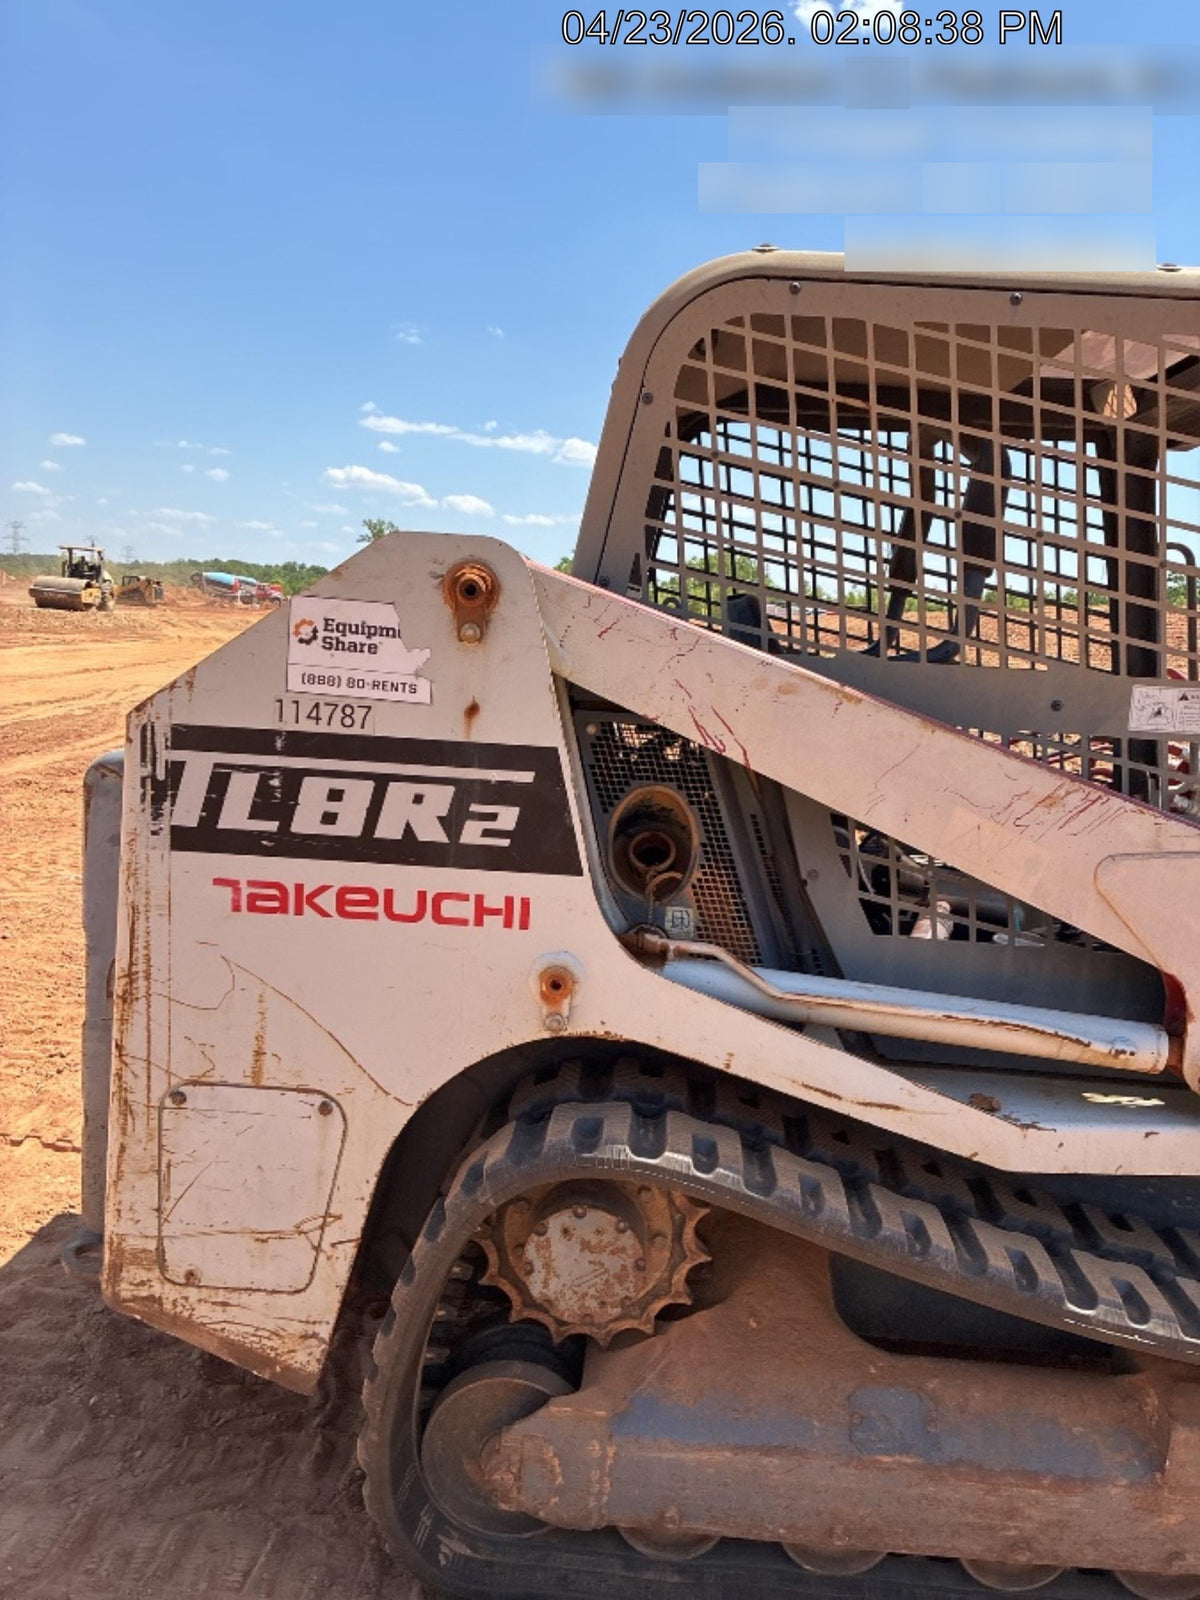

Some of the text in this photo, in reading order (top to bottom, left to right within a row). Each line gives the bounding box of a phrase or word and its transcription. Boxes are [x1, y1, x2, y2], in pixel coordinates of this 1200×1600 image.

[321, 635, 379, 655] Share
[301, 671, 342, 688] (888)
[274, 698, 373, 730] 114787
